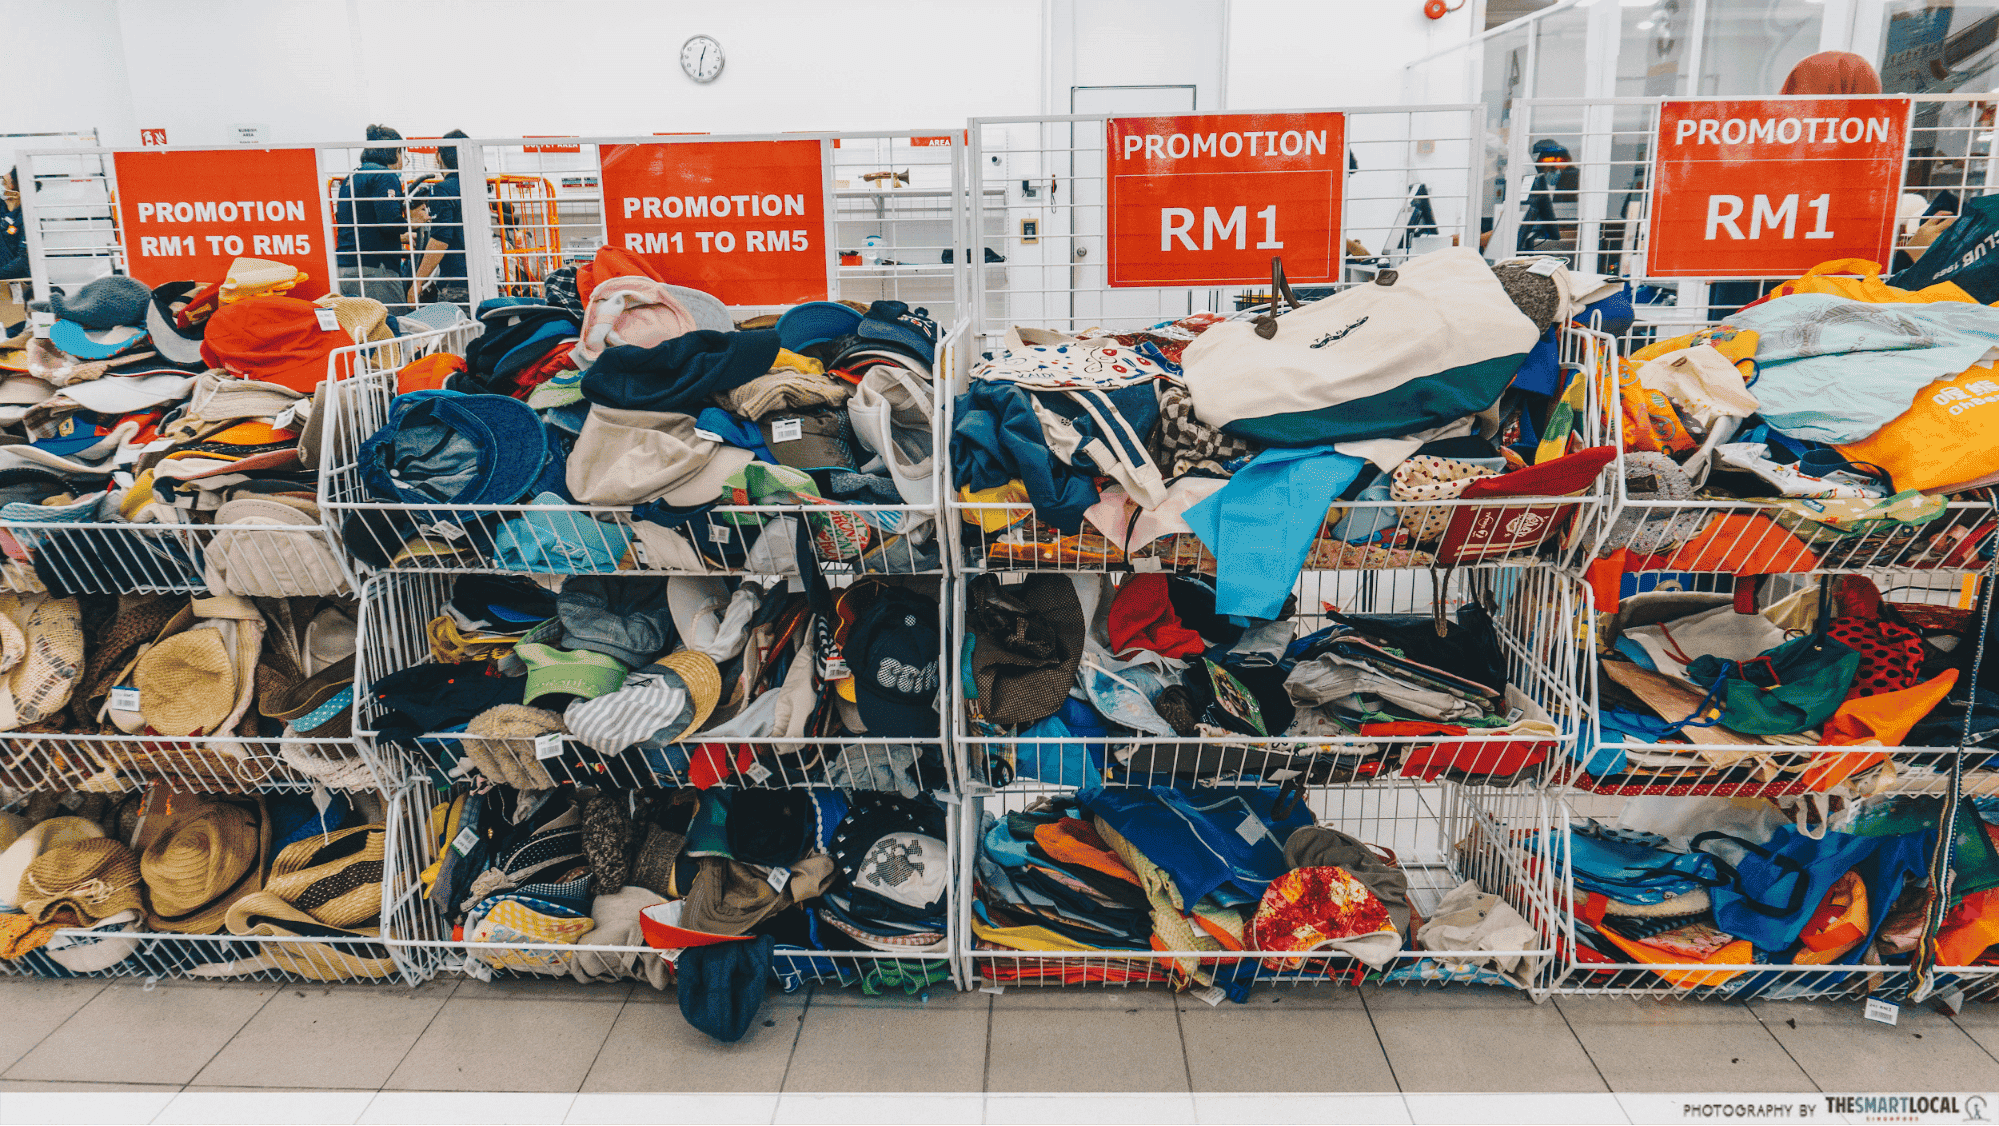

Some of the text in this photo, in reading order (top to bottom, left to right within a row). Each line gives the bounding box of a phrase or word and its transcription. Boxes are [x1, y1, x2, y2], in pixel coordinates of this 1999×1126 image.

[1124, 130, 1327, 160] PROMOTION
[1676, 116, 1890, 147] PROMOTION
[138, 200, 306, 223] PROMOTION
[623, 194, 805, 219] PROMOTION
[1704, 193, 1835, 241] RM1
[1161, 204, 1284, 252] RM1
[141, 234, 311, 257] RM1 TO RM5
[624, 230, 809, 254] RM1 TO RM5
